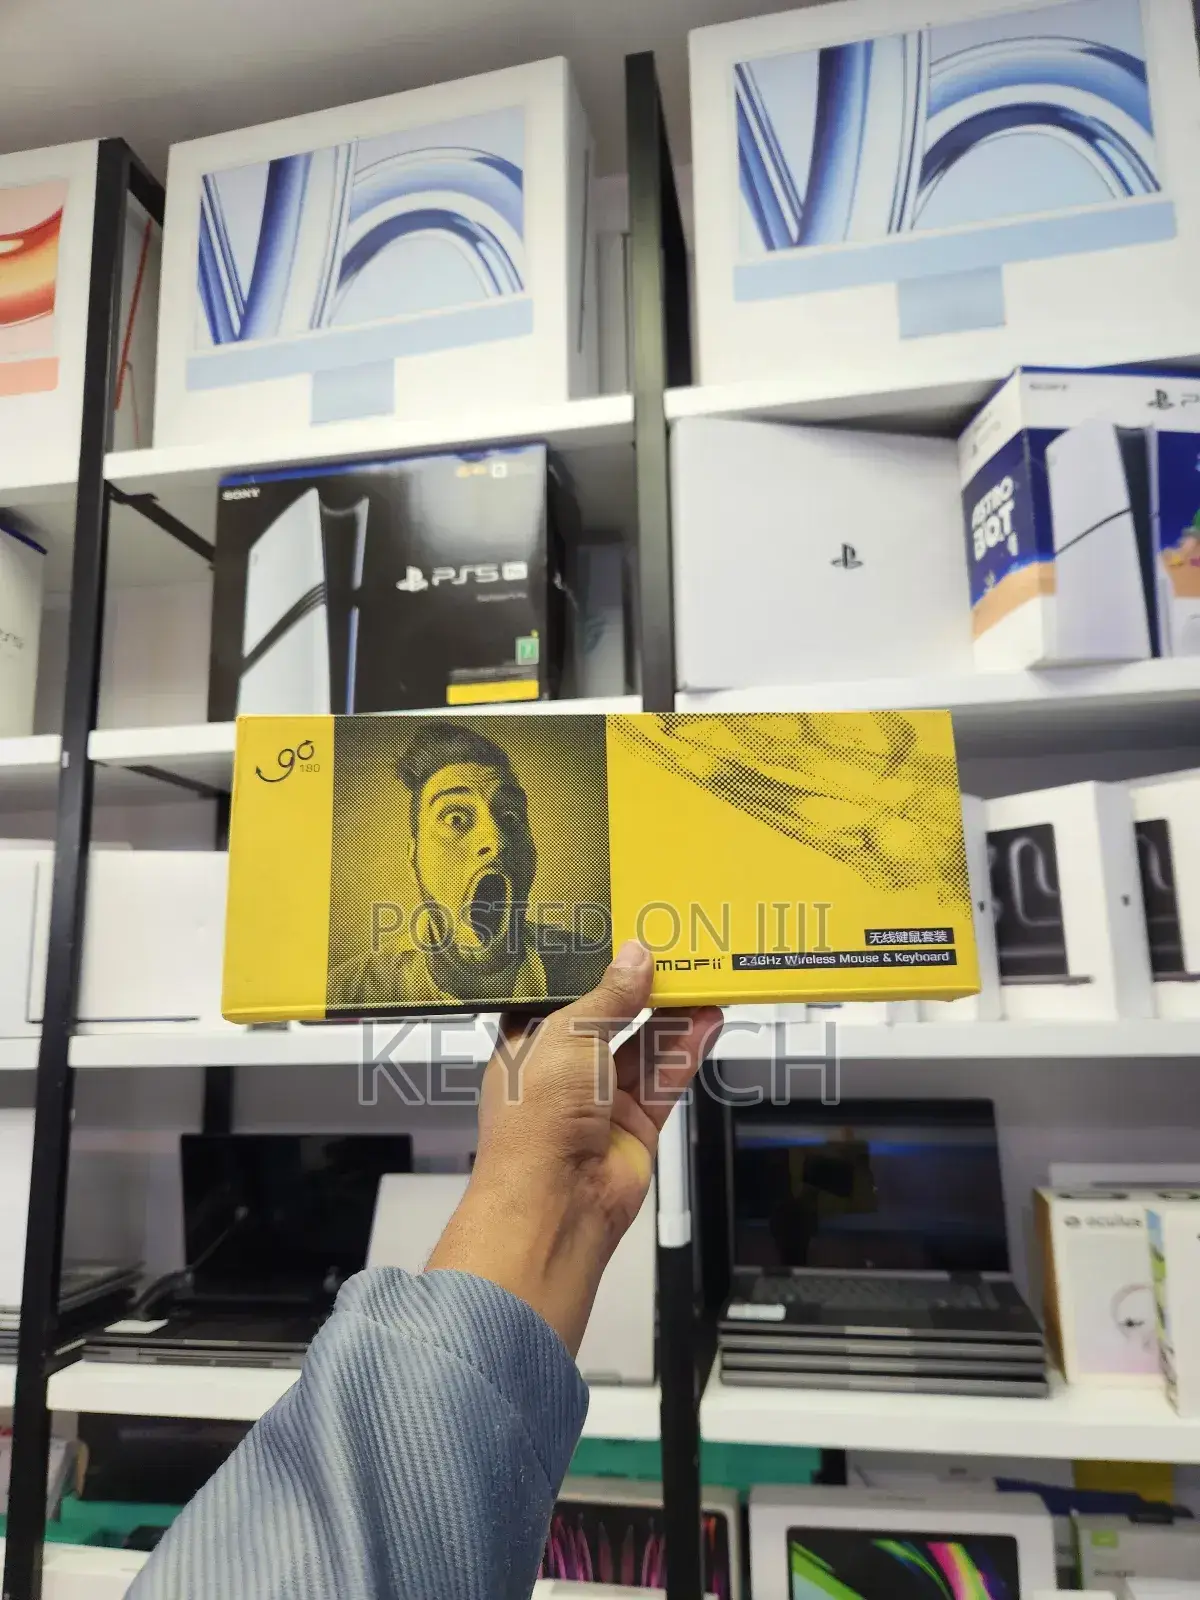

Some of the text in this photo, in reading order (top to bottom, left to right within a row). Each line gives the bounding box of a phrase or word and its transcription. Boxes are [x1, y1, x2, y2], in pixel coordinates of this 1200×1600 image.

[222, 487, 260, 500] SONY
[432, 563, 499, 586] PS5
[299, 763, 321, 773] 180
[869, 930, 948, 944] 无线键鼠套装
[739, 951, 949, 966] 2.4GHz Wireless Mouse & Keyboard
